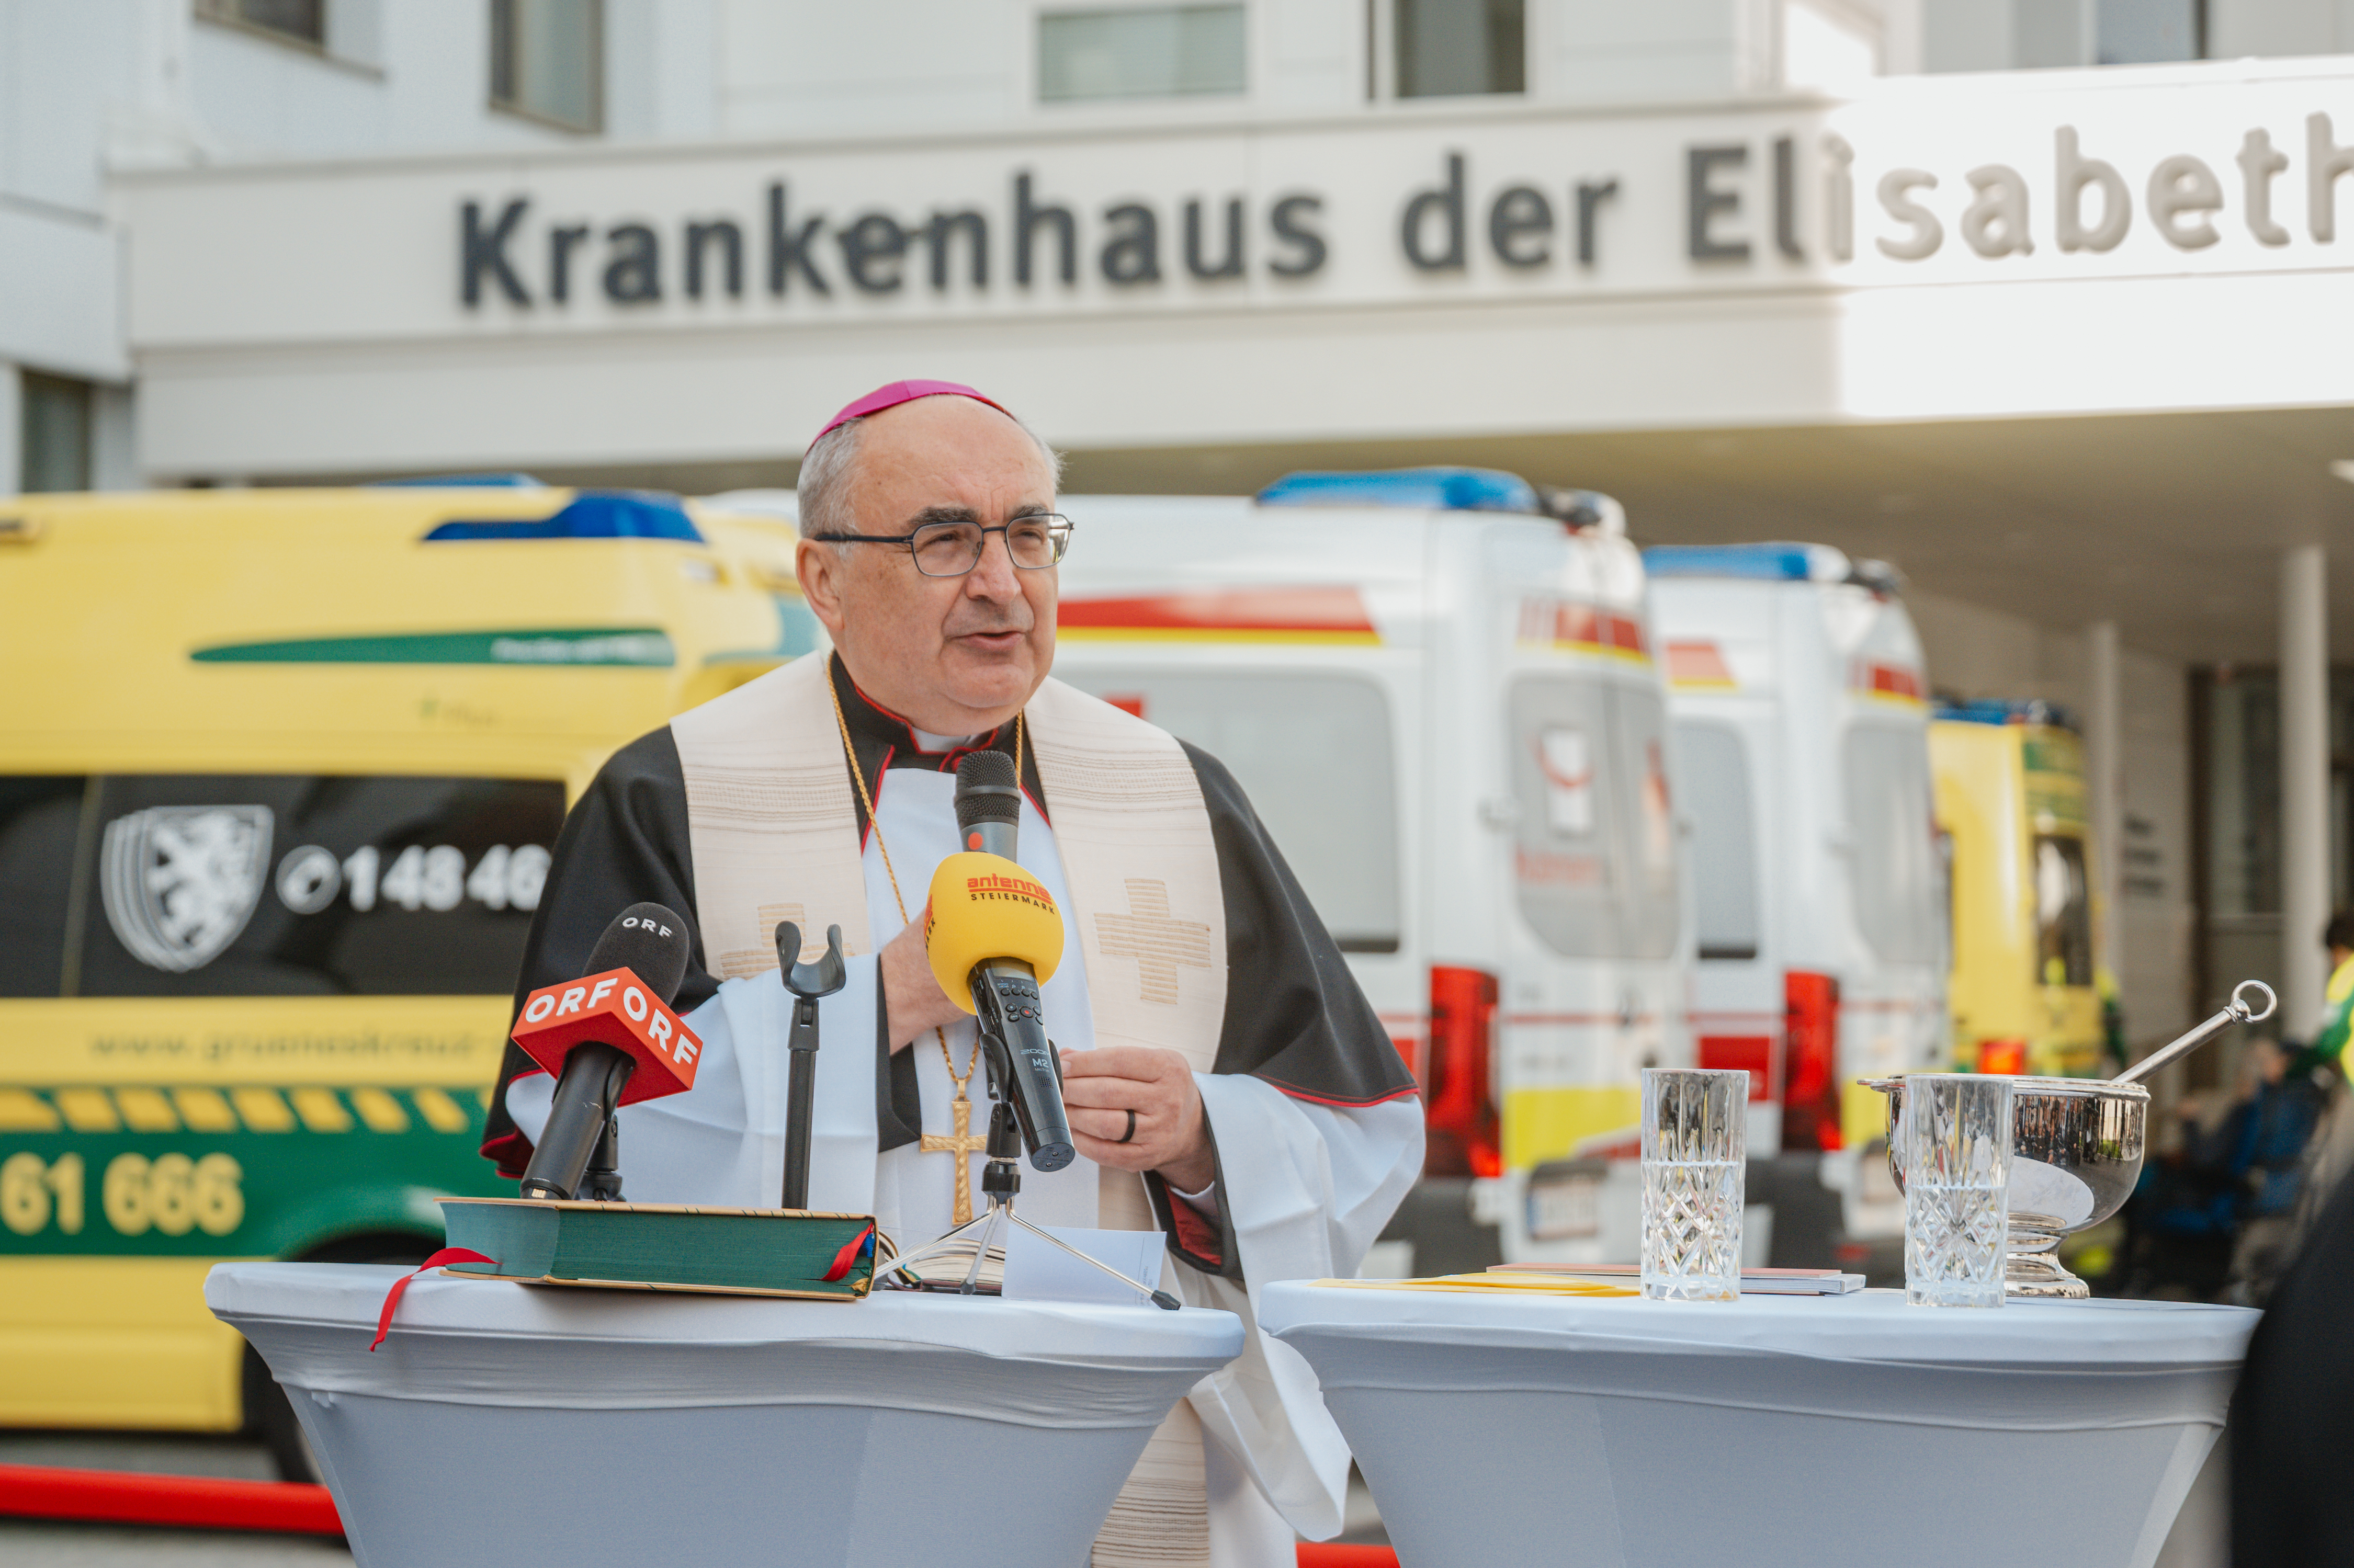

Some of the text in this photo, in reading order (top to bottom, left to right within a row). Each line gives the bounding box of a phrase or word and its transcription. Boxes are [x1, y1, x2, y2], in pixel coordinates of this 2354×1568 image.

[456, 111, 2353, 315] Krankenhaus der Elisabeth
[967, 873, 1051, 901] antenne
[970, 892, 1055, 915] STEIERMARK
[622, 917, 673, 938] ORF
[525, 978, 618, 1023] ORF
[623, 986, 698, 1064] ORF
[1032, 1058, 1049, 1068] M2
[1, 1154, 244, 1235] 61 666
